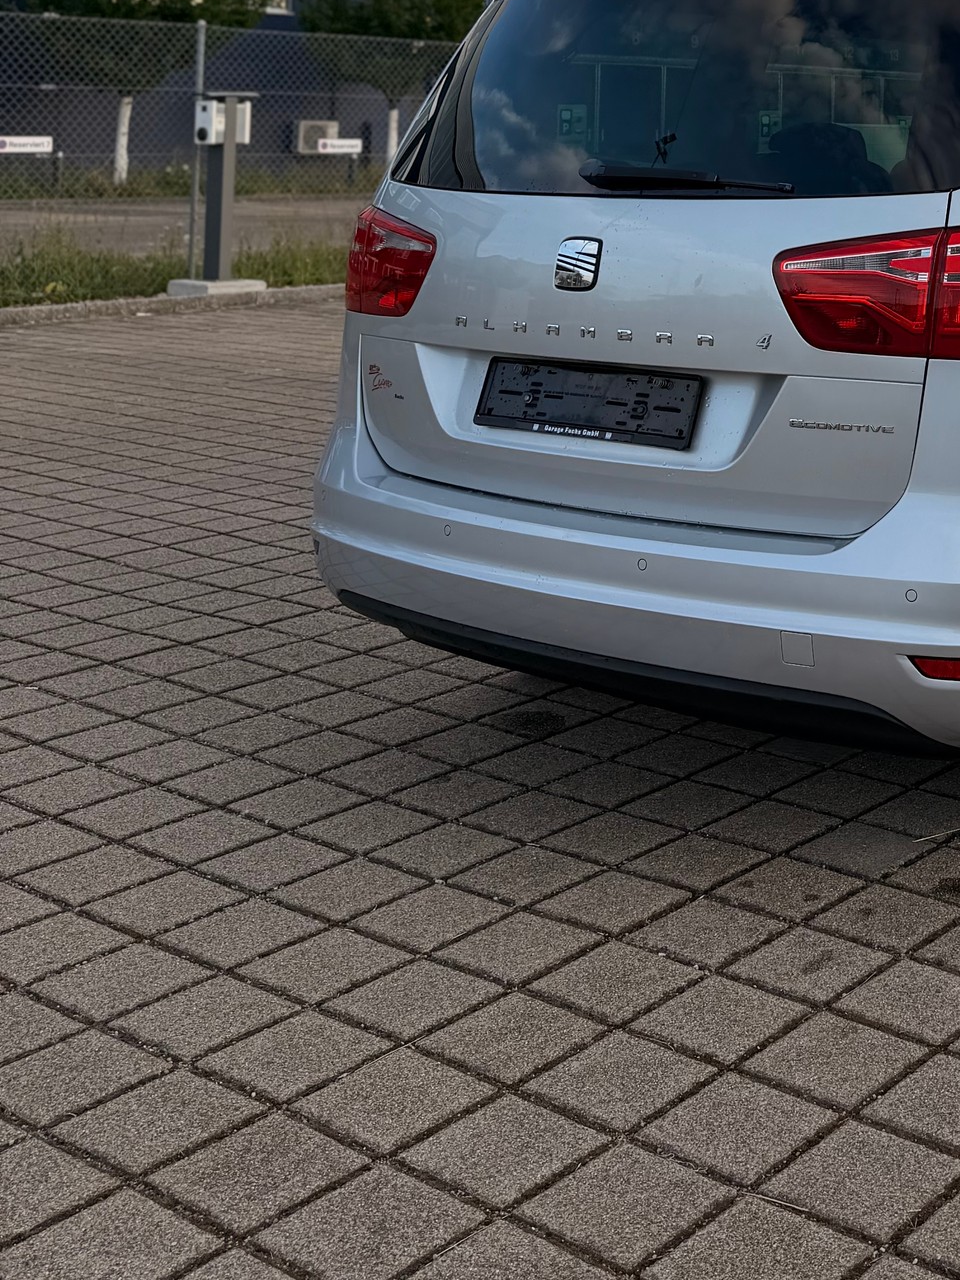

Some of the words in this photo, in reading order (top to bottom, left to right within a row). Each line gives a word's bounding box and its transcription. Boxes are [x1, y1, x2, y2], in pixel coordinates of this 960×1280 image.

[563, 122, 570, 134] P
[455, 315, 714, 347] ALHAMBRA
[756, 333, 772, 350] 4
[544, 424, 564, 434] Garage
[582, 429, 600, 437] GmbH
